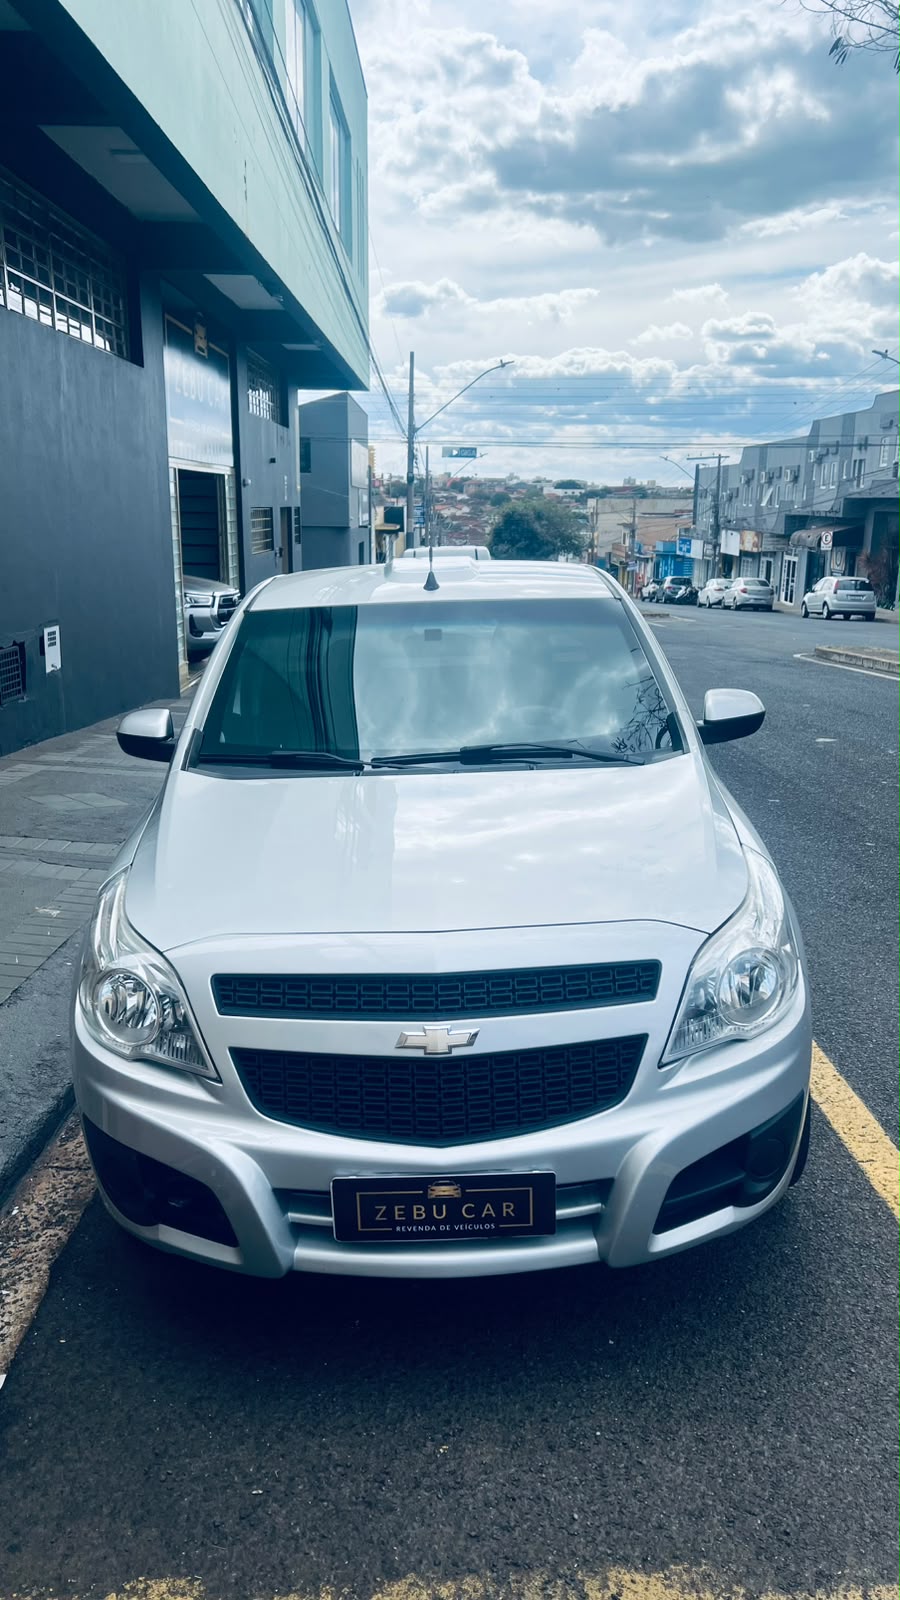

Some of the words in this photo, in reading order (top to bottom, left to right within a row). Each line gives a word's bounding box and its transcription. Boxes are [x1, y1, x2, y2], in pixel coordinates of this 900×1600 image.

[374, 1205, 447, 1221] ZEBU
[461, 1202, 516, 1219] CAR
[395, 1225, 437, 1233] REVENDA
[454, 1223, 496, 1231] VEÍCULOS
